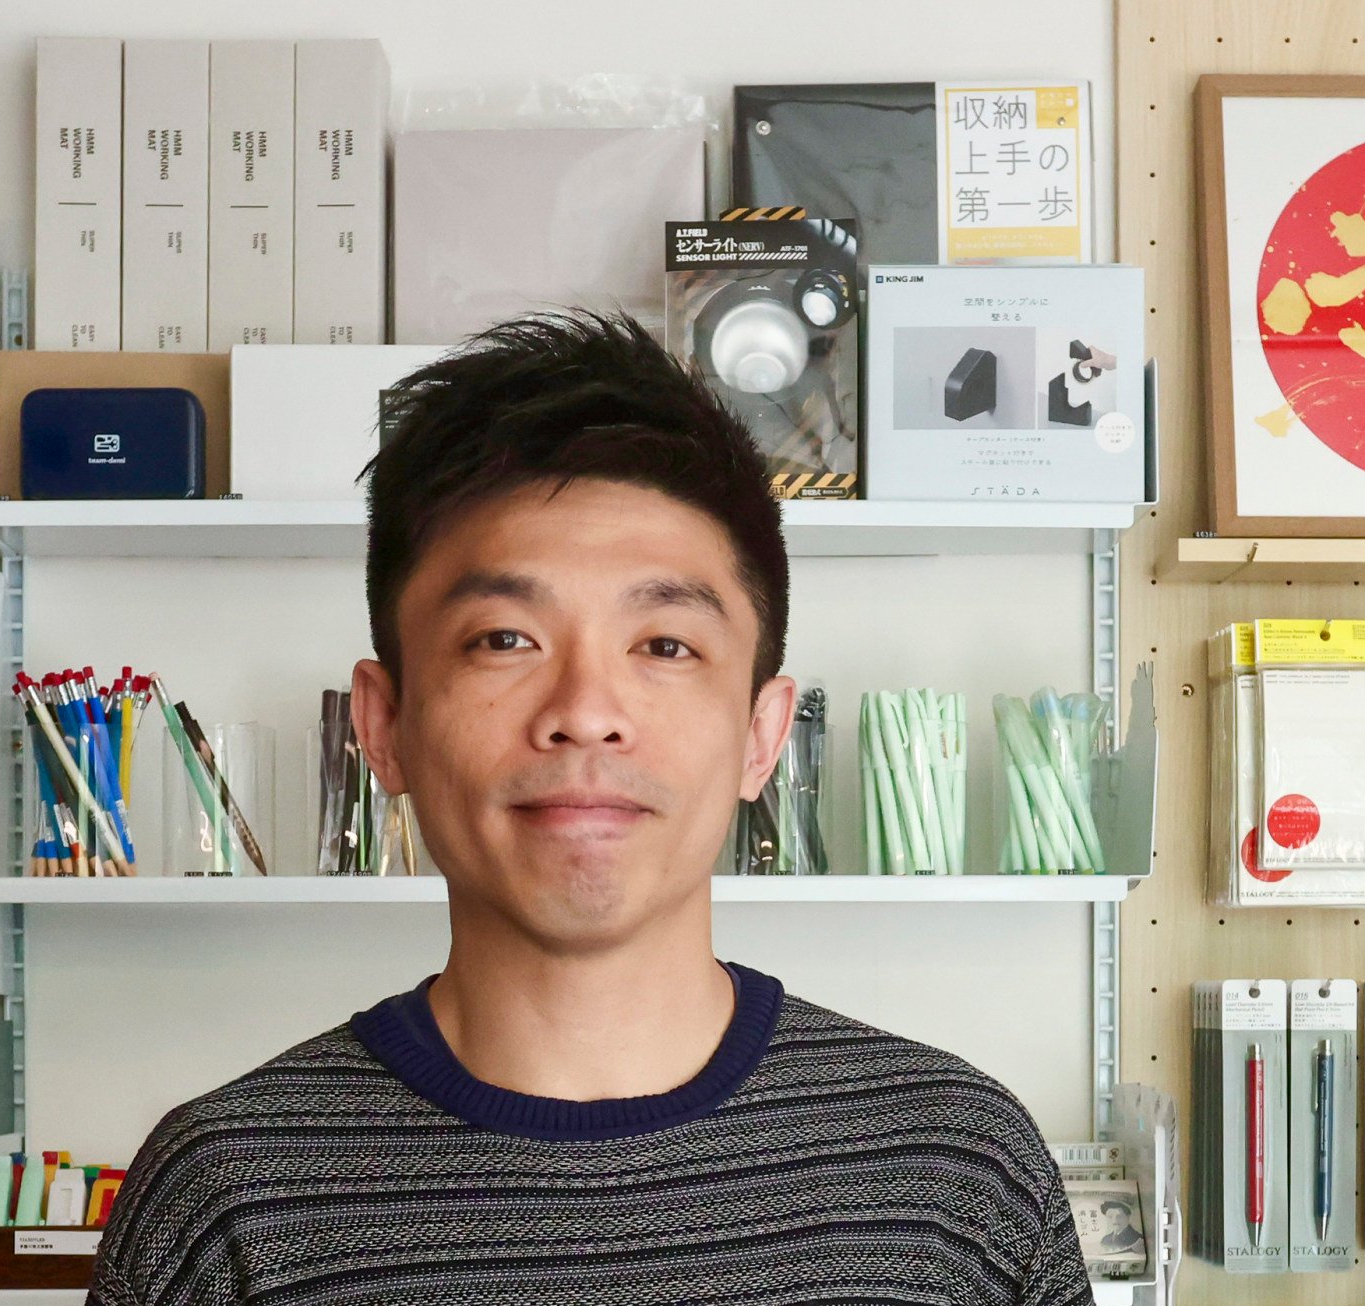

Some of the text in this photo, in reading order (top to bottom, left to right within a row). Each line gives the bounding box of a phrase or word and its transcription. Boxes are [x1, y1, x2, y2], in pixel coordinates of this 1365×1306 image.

[954, 95, 1027, 130] 収納
[60, 128, 69, 149] MAT
[86, 128, 95, 155] HMM
[148, 129, 156, 151] MAT
[174, 129, 182, 156] HMM
[233, 131, 241, 152] MAT
[259, 131, 267, 157] HMM
[319, 129, 327, 152] MAT
[345, 129, 353, 156] HMM
[73, 127, 82, 179] WORKING
[160, 129, 169, 180] WORKING
[245, 131, 254, 182] WORKING
[331, 129, 340, 181] WORKING
[955, 140, 1070, 175] 上手の
[956, 186, 1073, 223] 第一歩
[676, 229, 707, 237] A.T.FIELD
[676, 238, 737, 252] センサーライト
[676, 253, 737, 262] SENSOR LIGHT
[886, 275, 924, 283] KING JIM
[991, 313, 1022, 322] 整える
[81, 325, 86, 334] TO
[167, 326, 173, 336] TO
[252, 327, 258, 337] TO
[339, 326, 345, 336] TO
[1227, 1245, 1282, 1257] STALOGY
[1293, 1245, 1349, 1257] STALOGY
